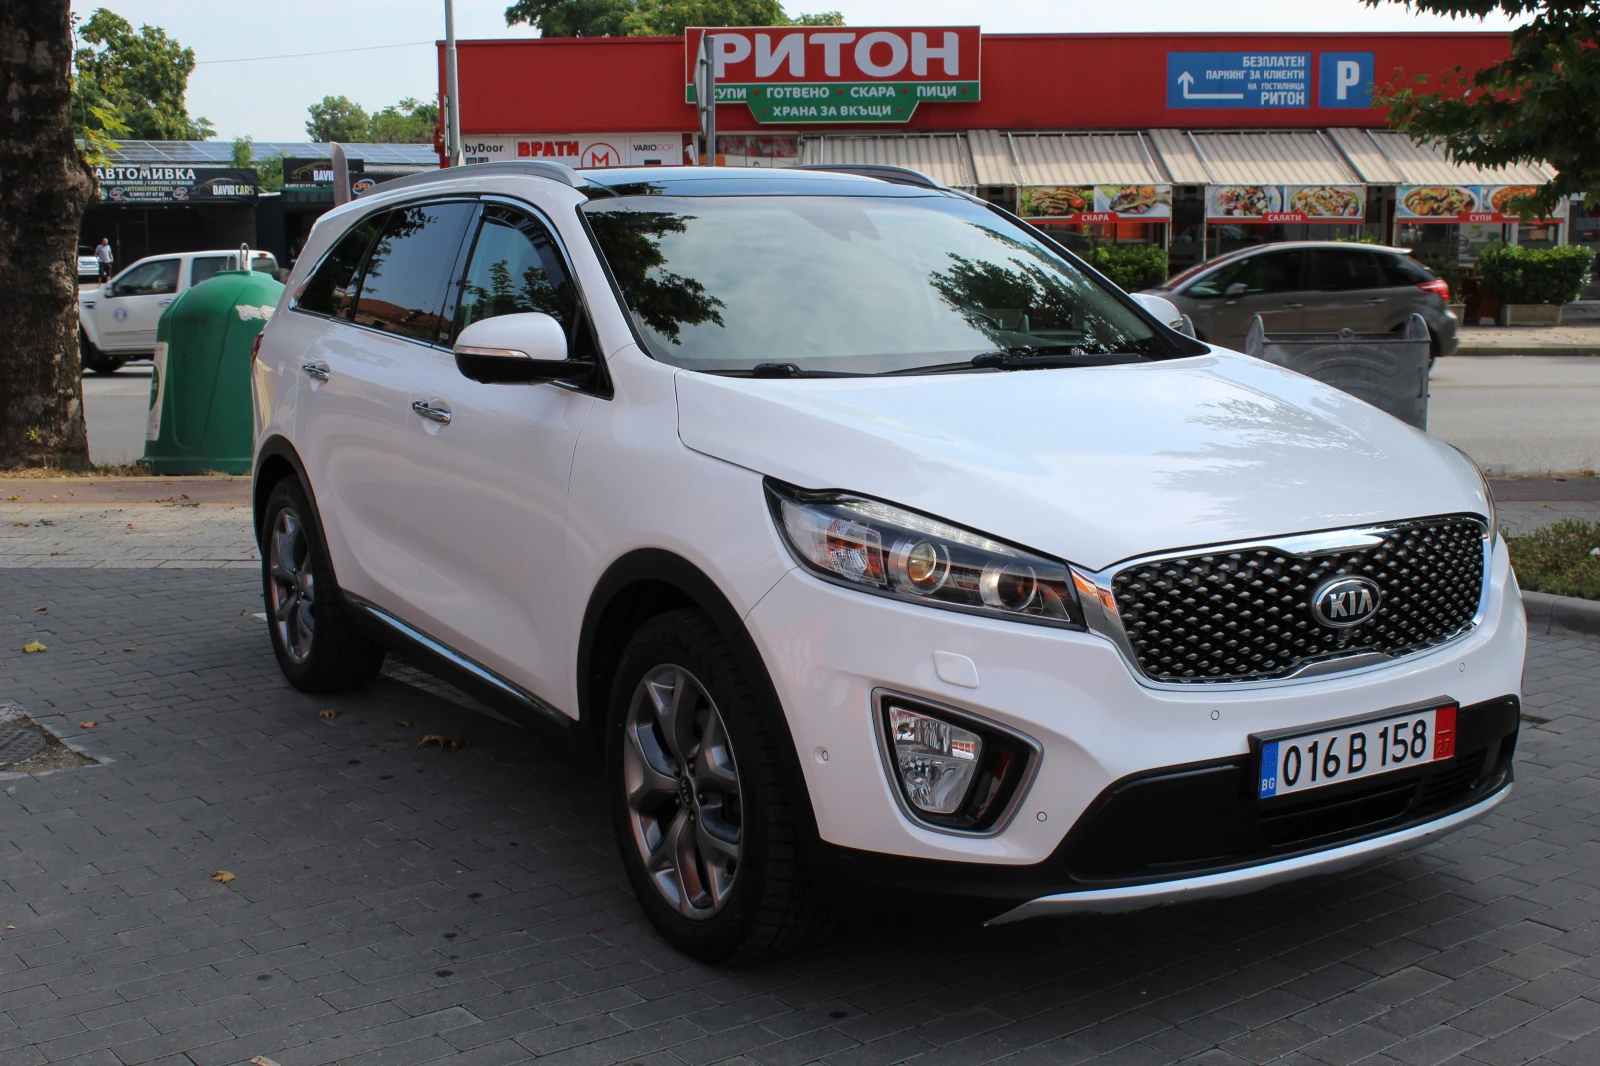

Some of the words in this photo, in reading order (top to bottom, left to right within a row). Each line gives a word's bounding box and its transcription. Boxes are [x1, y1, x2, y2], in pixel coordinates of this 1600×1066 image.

[707, 31, 959, 78] РИТОН
[1242, 56, 1305, 67] БЕЗПЛАТЕН
[1206, 70, 1247, 79] ПАРКИНГ
[1250, 70, 1261, 79] ЗА
[1263, 70, 1305, 79] КЛИЕНТИ
[1337, 60, 1360, 100] P
[767, 87, 830, 98] ГОТВЕНО
[850, 86, 896, 97] СКАРА
[916, 86, 957, 98] ПИЦИ
[1261, 82, 1305, 90] ГОСТИЛНИЦА
[1261, 92, 1305, 105] РИТОН
[773, 106, 818, 116] ХРАНА
[820, 106, 837, 116] ЗА
[840, 105, 892, 117] ВКЪЩИ
[518, 141, 579, 157] ВРАТИ
[95, 168, 196, 180] АВТОМИВКА
[213, 184, 235, 196] DAVID
[235, 184, 255, 196] CARS
[1081, 213, 1109, 222] СКАРА
[1268, 213, 1302, 222] САЛАТИ
[1469, 213, 1492, 222] СУПИ
[1329, 589, 1373, 618] KIA
[1378, 719, 1427, 767] 158
[1261, 777, 1276, 792] BG
